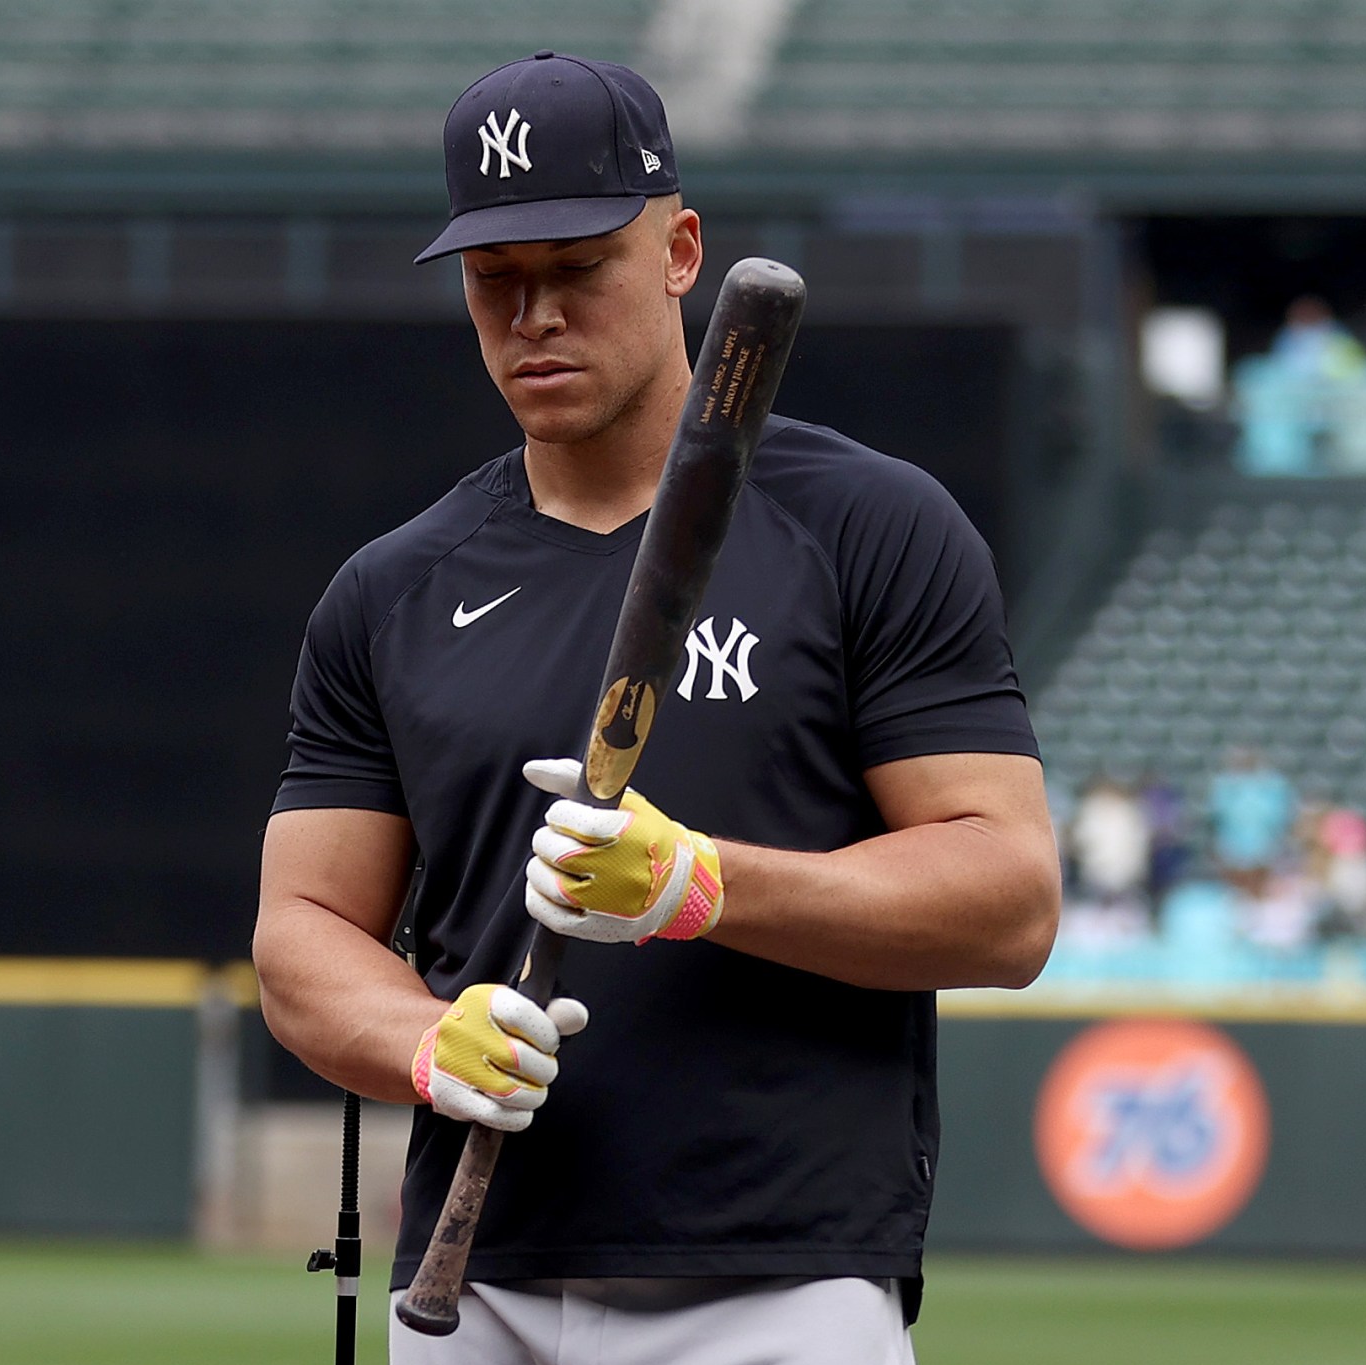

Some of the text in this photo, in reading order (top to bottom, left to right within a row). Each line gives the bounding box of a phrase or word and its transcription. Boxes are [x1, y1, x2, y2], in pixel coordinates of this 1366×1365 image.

[478, 108, 532, 178] NY
[721, 380, 740, 417] AARON
[732, 346, 751, 382] JUDGE
[676, 616, 760, 702] NY
[1080, 1058, 1232, 1194] 76
